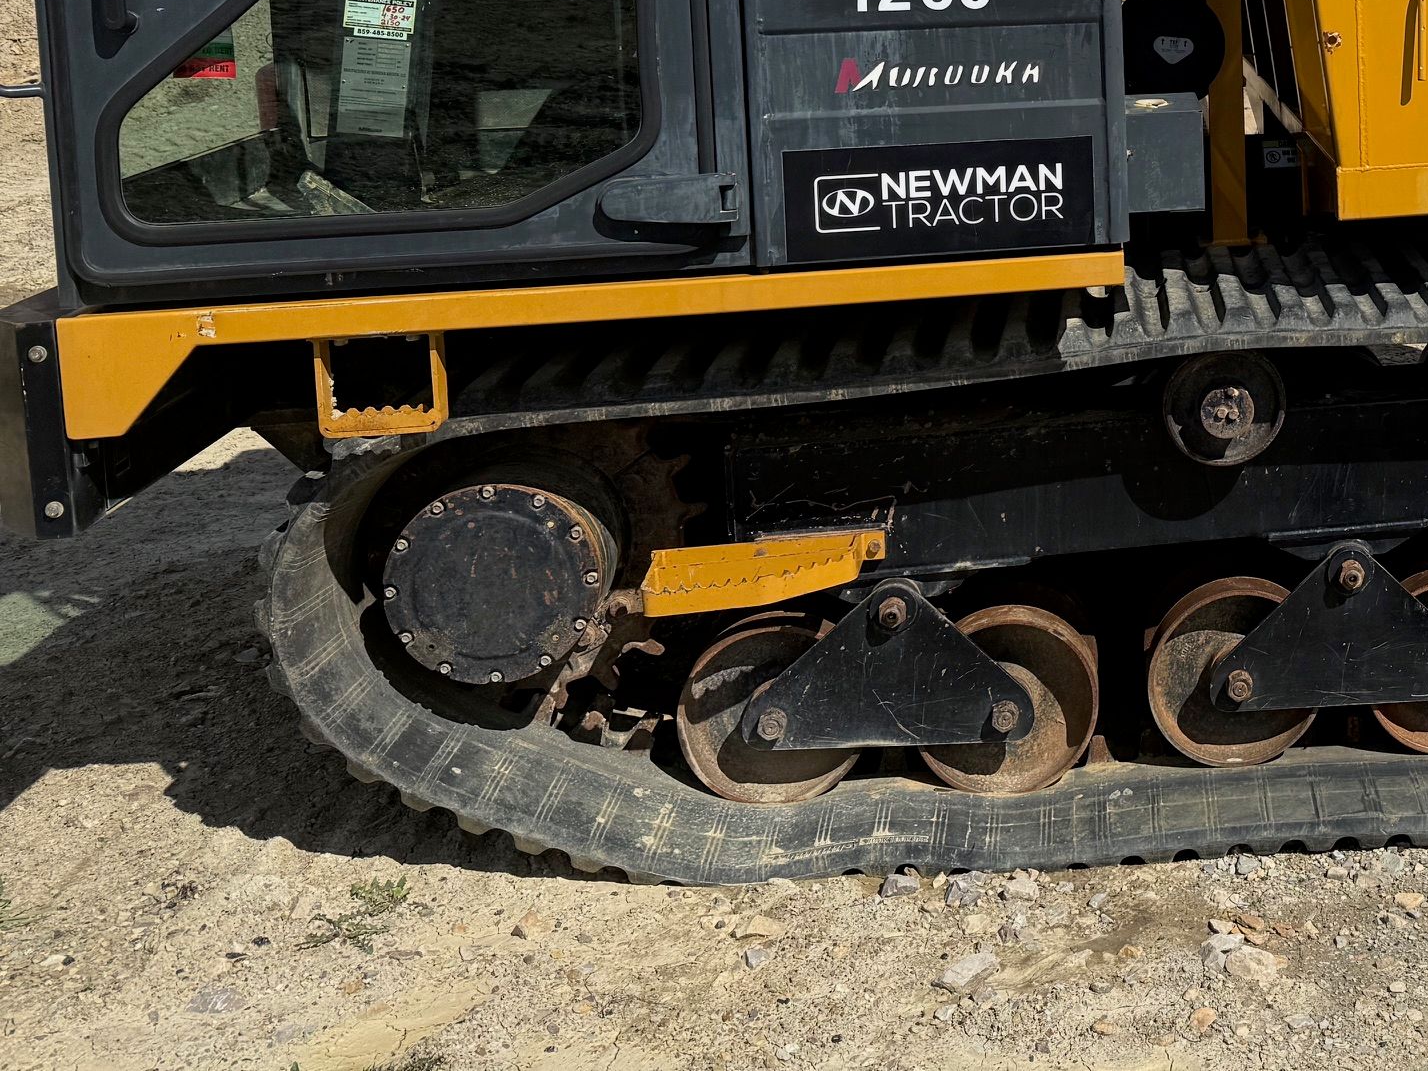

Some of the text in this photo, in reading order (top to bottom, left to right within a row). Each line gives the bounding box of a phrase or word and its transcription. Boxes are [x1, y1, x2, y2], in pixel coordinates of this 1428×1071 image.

[357, 28, 404, 38] 859-485-8500
[209, 64, 230, 73] RENT
[881, 162, 1063, 200] NEWMAN
[882, 192, 1064, 229] TRACTOR
